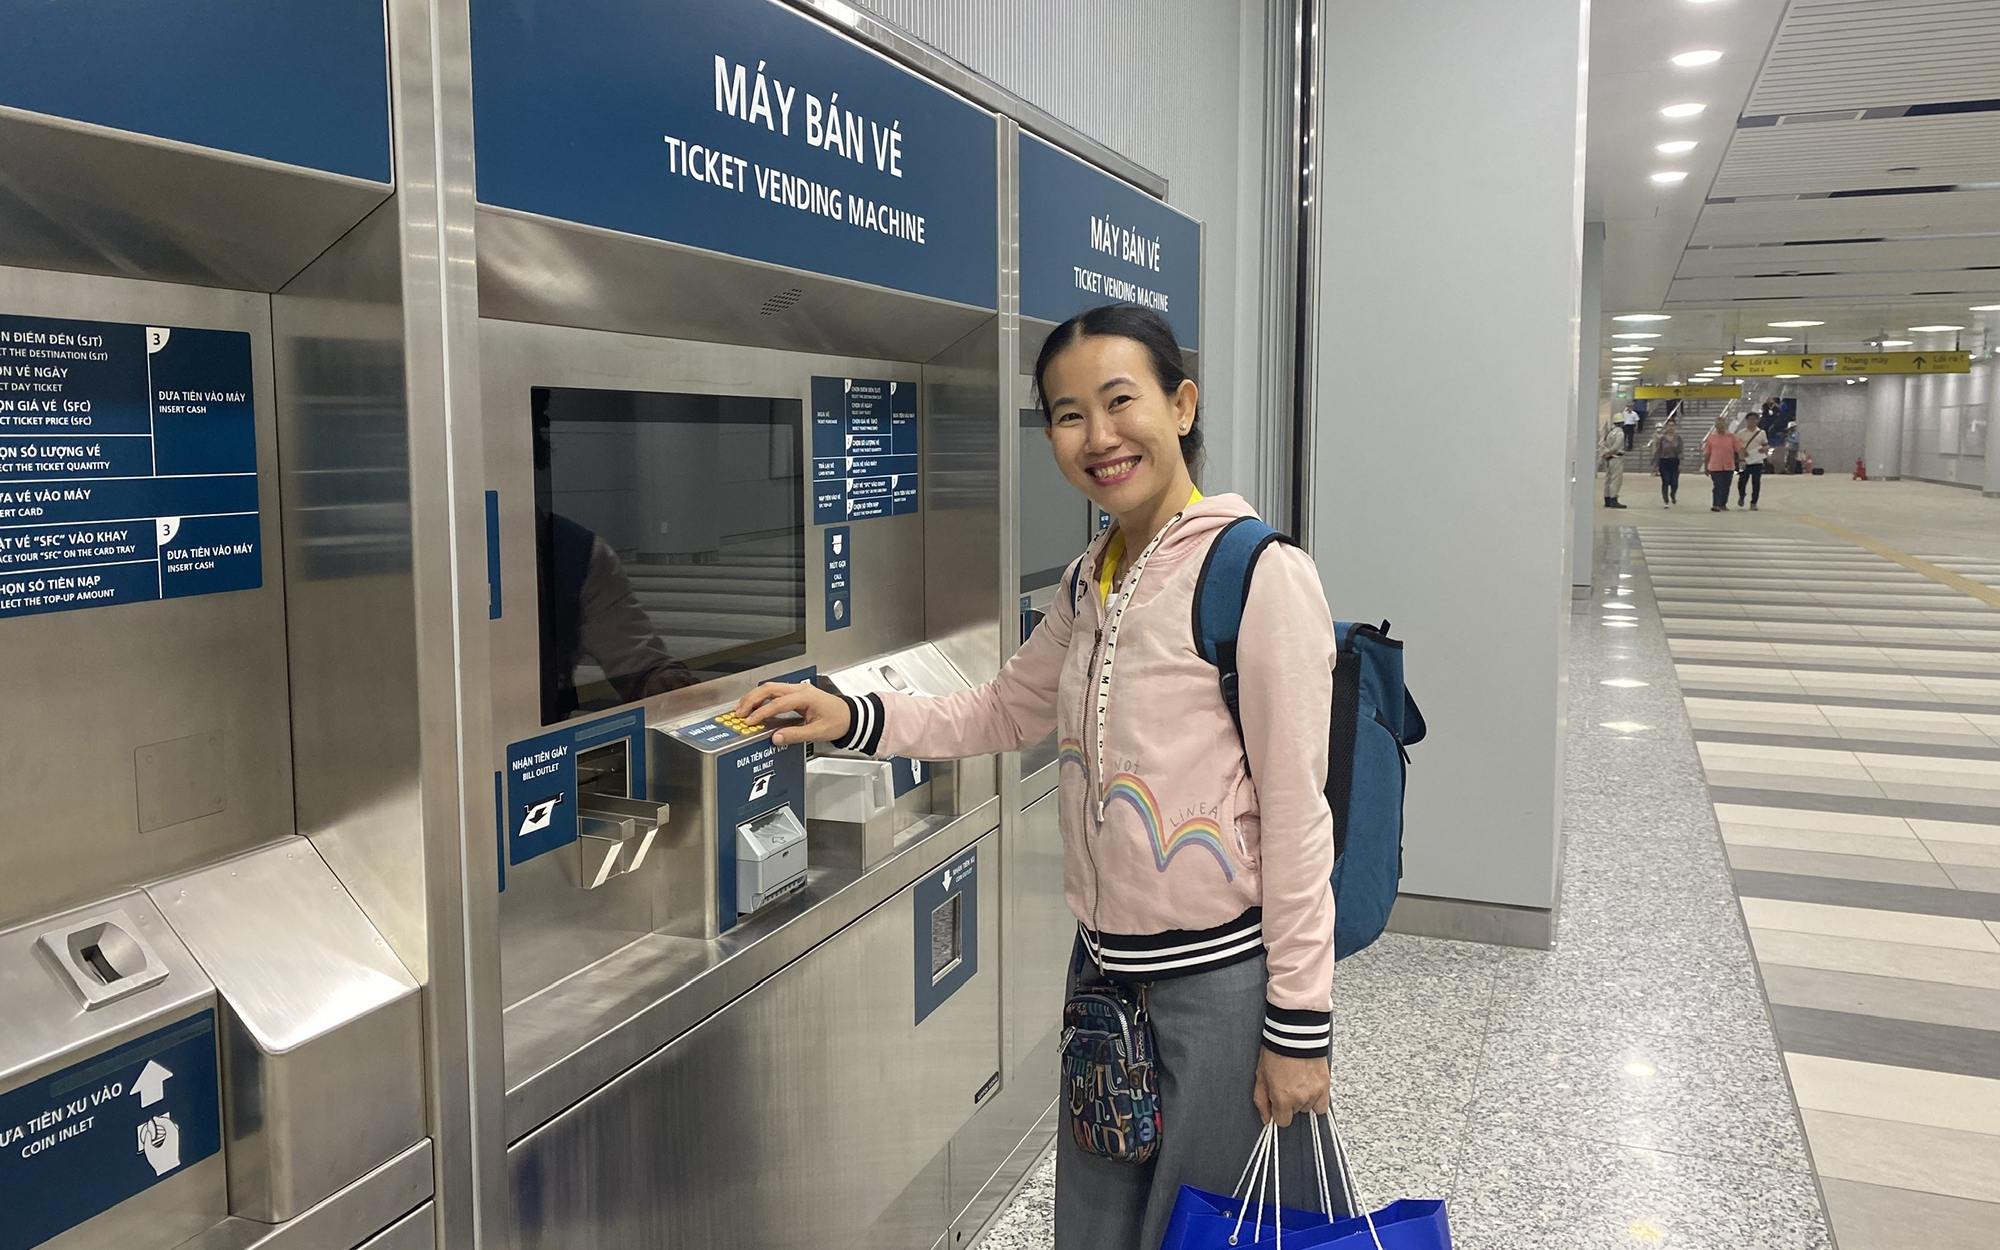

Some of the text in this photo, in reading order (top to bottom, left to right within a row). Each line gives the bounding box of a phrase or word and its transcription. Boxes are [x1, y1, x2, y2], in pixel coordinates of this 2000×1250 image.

[714, 53, 902, 178] MÁY BÁN VÉ
[664, 134, 926, 245] TICKET VENDING MACHINE
[1090, 214, 1160, 272] MÁY BÁN VÉ
[1073, 266, 1169, 312] TICKET VENDING MACHINE
[77, 333, 103, 347] (SJT)
[153, 333, 160, 345] 3
[9, 348, 27, 357] THE
[29, 349, 87, 360] DESTINATION
[88, 351, 108, 361] (SJT)
[15, 364, 31, 377] VÉ
[34, 365, 68, 378] NGÀY
[11, 382, 31, 391] DAY
[33, 383, 63, 392] TICKET
[158, 390, 181, 401] ĐƯA
[204, 389, 224, 402] VÀO
[225, 390, 246, 402] MÁY
[17, 398, 39, 412] GIÁ
[42, 398, 57, 412] VÉ
[63, 399, 91, 412] (SFC)
[159, 405, 207, 414] INSERT CASH
[12, 416, 43, 426] TICKET
[45, 416, 69, 426] PRICE
[70, 416, 92, 426] (SFC)
[0, 445, 17, 460] ỌN
[40, 446, 84, 460] LƯỢNG
[86, 443, 101, 457] VÉ
[15, 463, 33, 472] THE
[35, 462, 65, 471] TICKET
[66, 461, 111, 472] QUANTITY
[15, 489, 31, 503] VÉ
[34, 488, 61, 502] VÀO
[64, 487, 91, 501] MÁY
[0, 507, 43, 518] ERT CARD
[163, 524, 171, 536] 3
[14, 534, 31, 548] VÉ
[68, 531, 94, 545] VÀO
[96, 530, 128, 542] KHAY
[14, 552, 39, 561] YOUR
[63, 549, 76, 559] ON
[77, 548, 92, 557] THE
[93, 546, 115, 556] CARD
[115, 545, 136, 554] TRAY
[166, 549, 189, 560] ĐƯA
[211, 544, 231, 556] VÀO
[233, 542, 253, 554] MÁY
[167, 561, 214, 573] INSERT CASH
[0, 582, 25, 597] HỌN
[77, 575, 101, 589] NẠP
[0, 588, 115, 609] LECT THE TOP-UP AMOUNT
[522, 763, 559, 781] BILL OUTLET
[762, 759, 774, 770] INLET
[0, 1082, 123, 1148] ƯA TIỀN XU VÀO
[21, 1116, 95, 1159] COIN INLET
